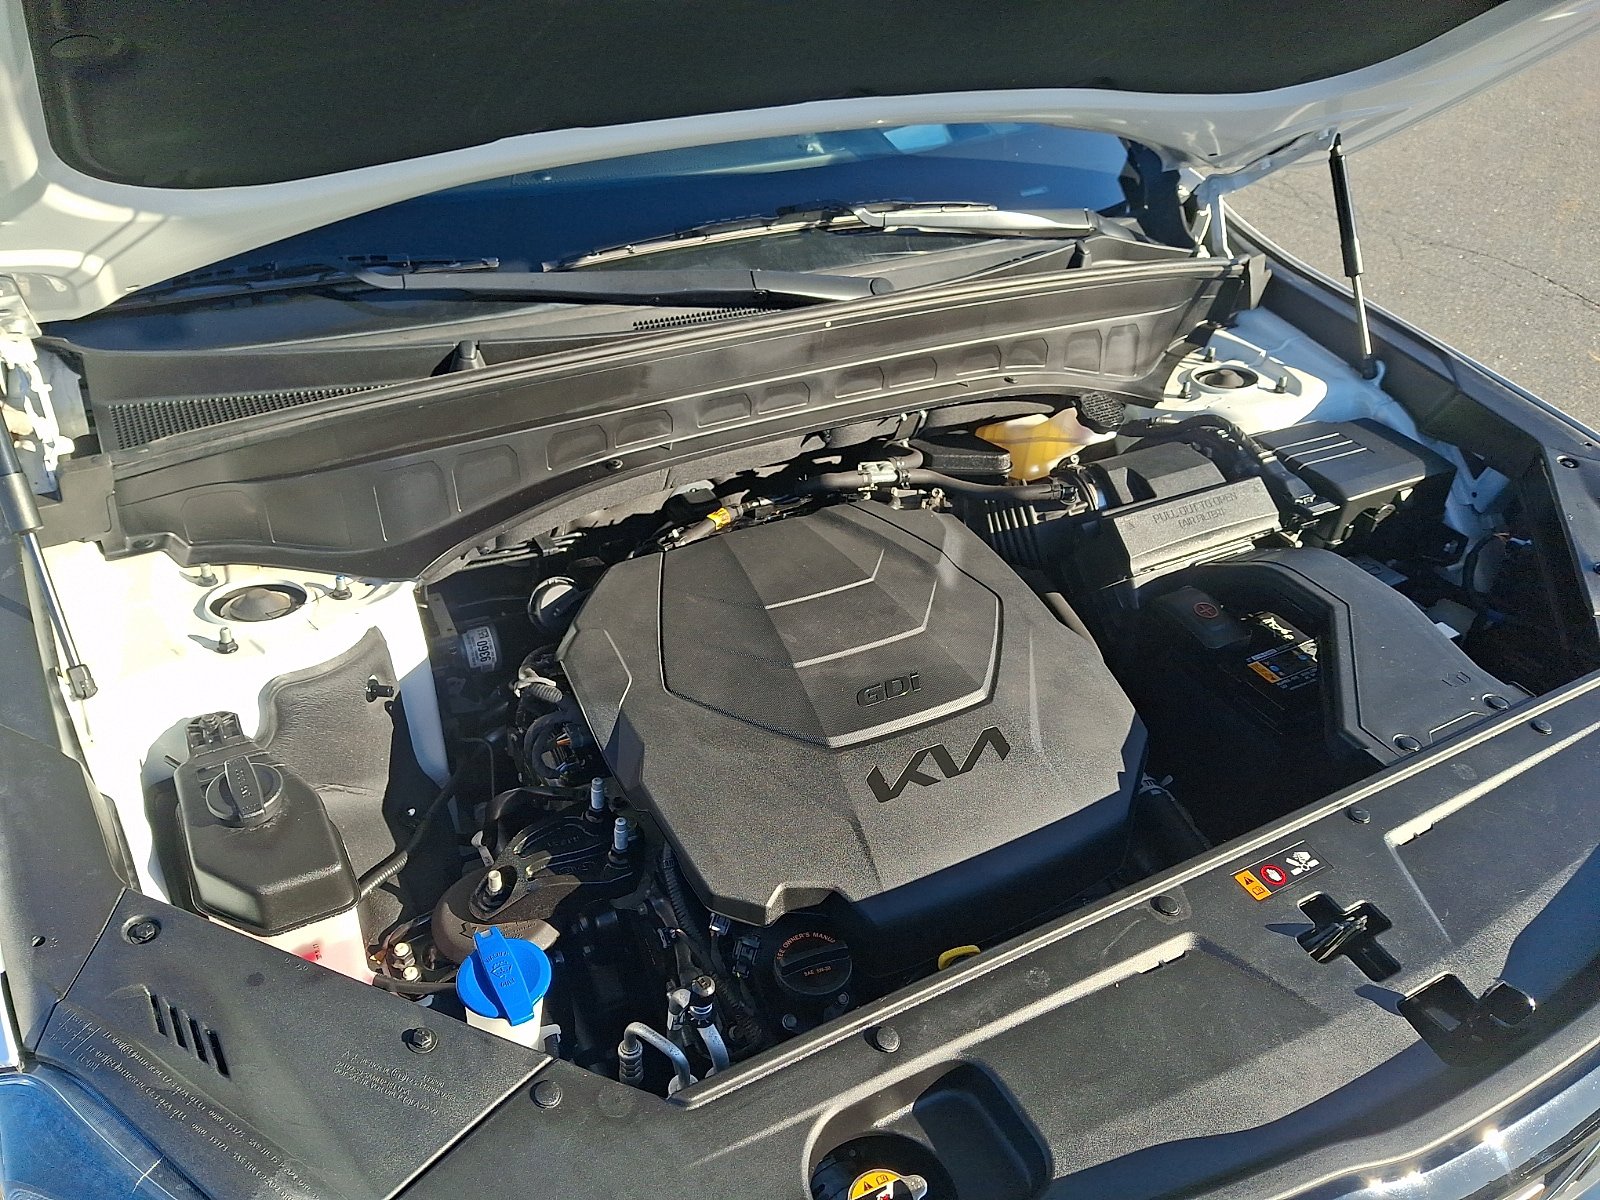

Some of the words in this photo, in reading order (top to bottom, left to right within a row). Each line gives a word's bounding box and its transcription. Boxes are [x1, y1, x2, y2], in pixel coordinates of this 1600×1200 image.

[1152, 510, 1179, 524] PULL
[1180, 504, 1199, 517] OUT
[1200, 499, 1213, 510] TO
[1213, 492, 1238, 506] OPEN
[477, 640, 491, 663] 9360
[866, 725, 1011, 803] KIA
[776, 949, 786, 960] SEE
[783, 932, 811, 949] OWNER'S
